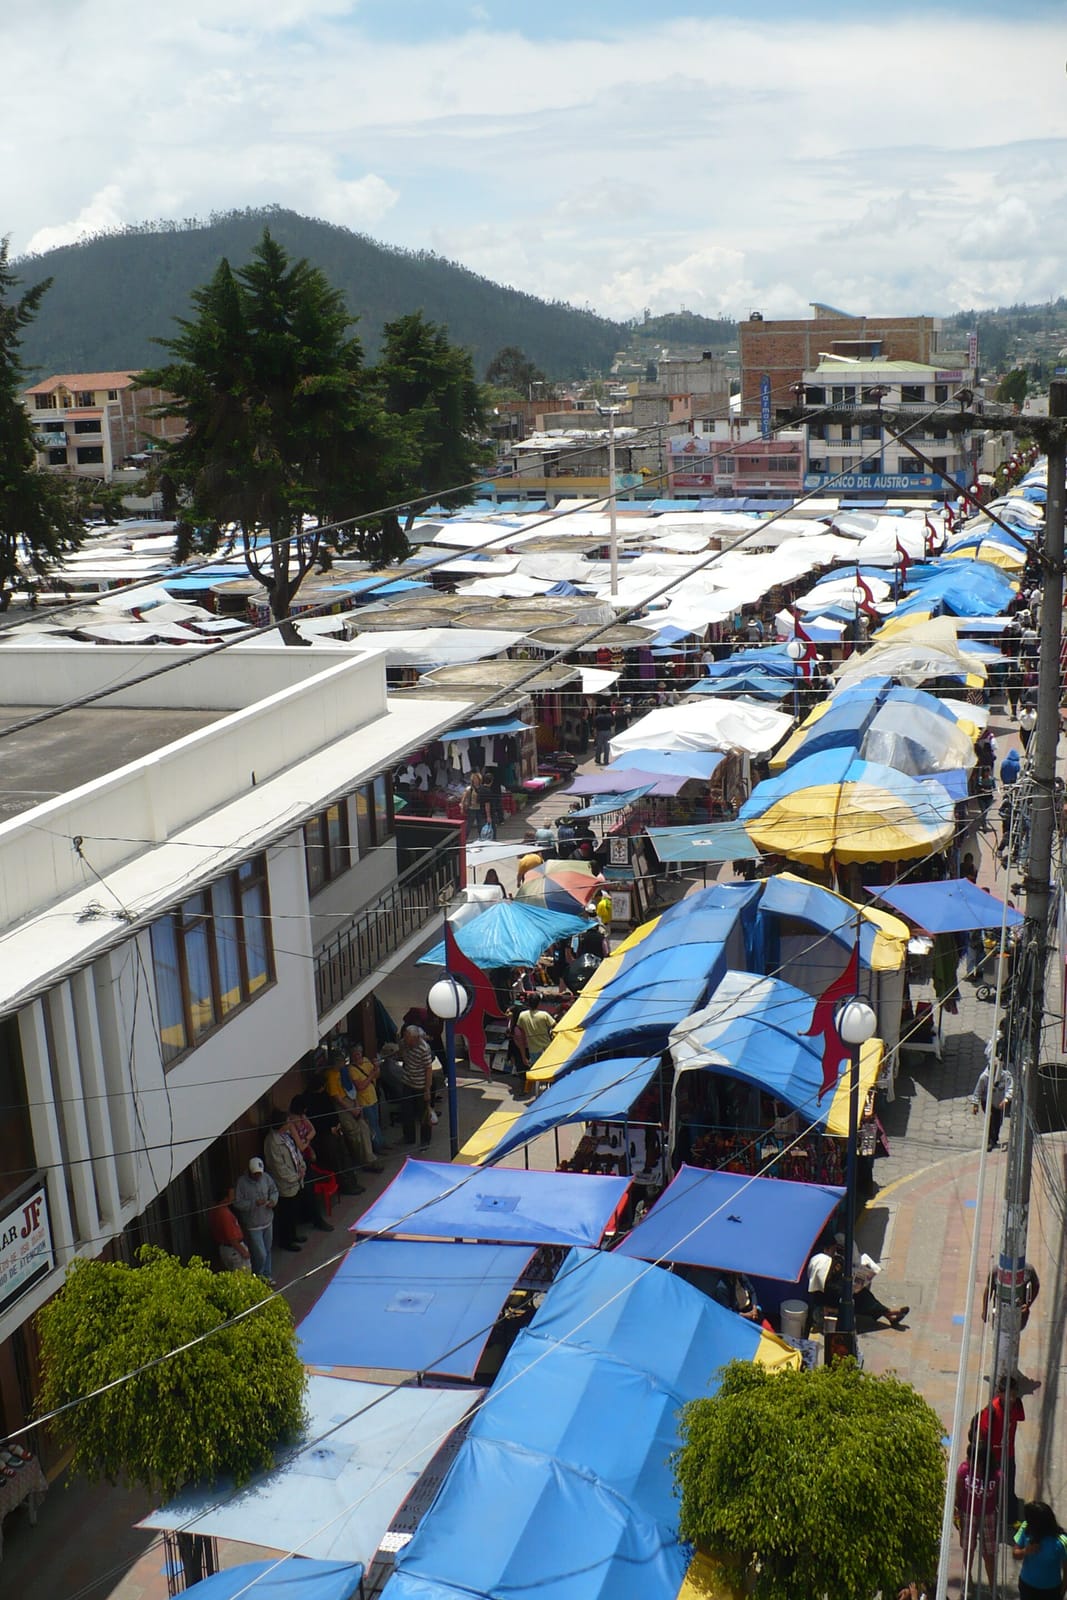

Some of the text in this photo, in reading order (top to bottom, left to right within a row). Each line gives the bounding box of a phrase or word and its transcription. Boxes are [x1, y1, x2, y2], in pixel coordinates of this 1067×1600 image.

[823, 476, 909, 489] BANCO DEL AUSTRO
[0, 1225, 18, 1253] AR
[20, 1196, 43, 1239] JF
